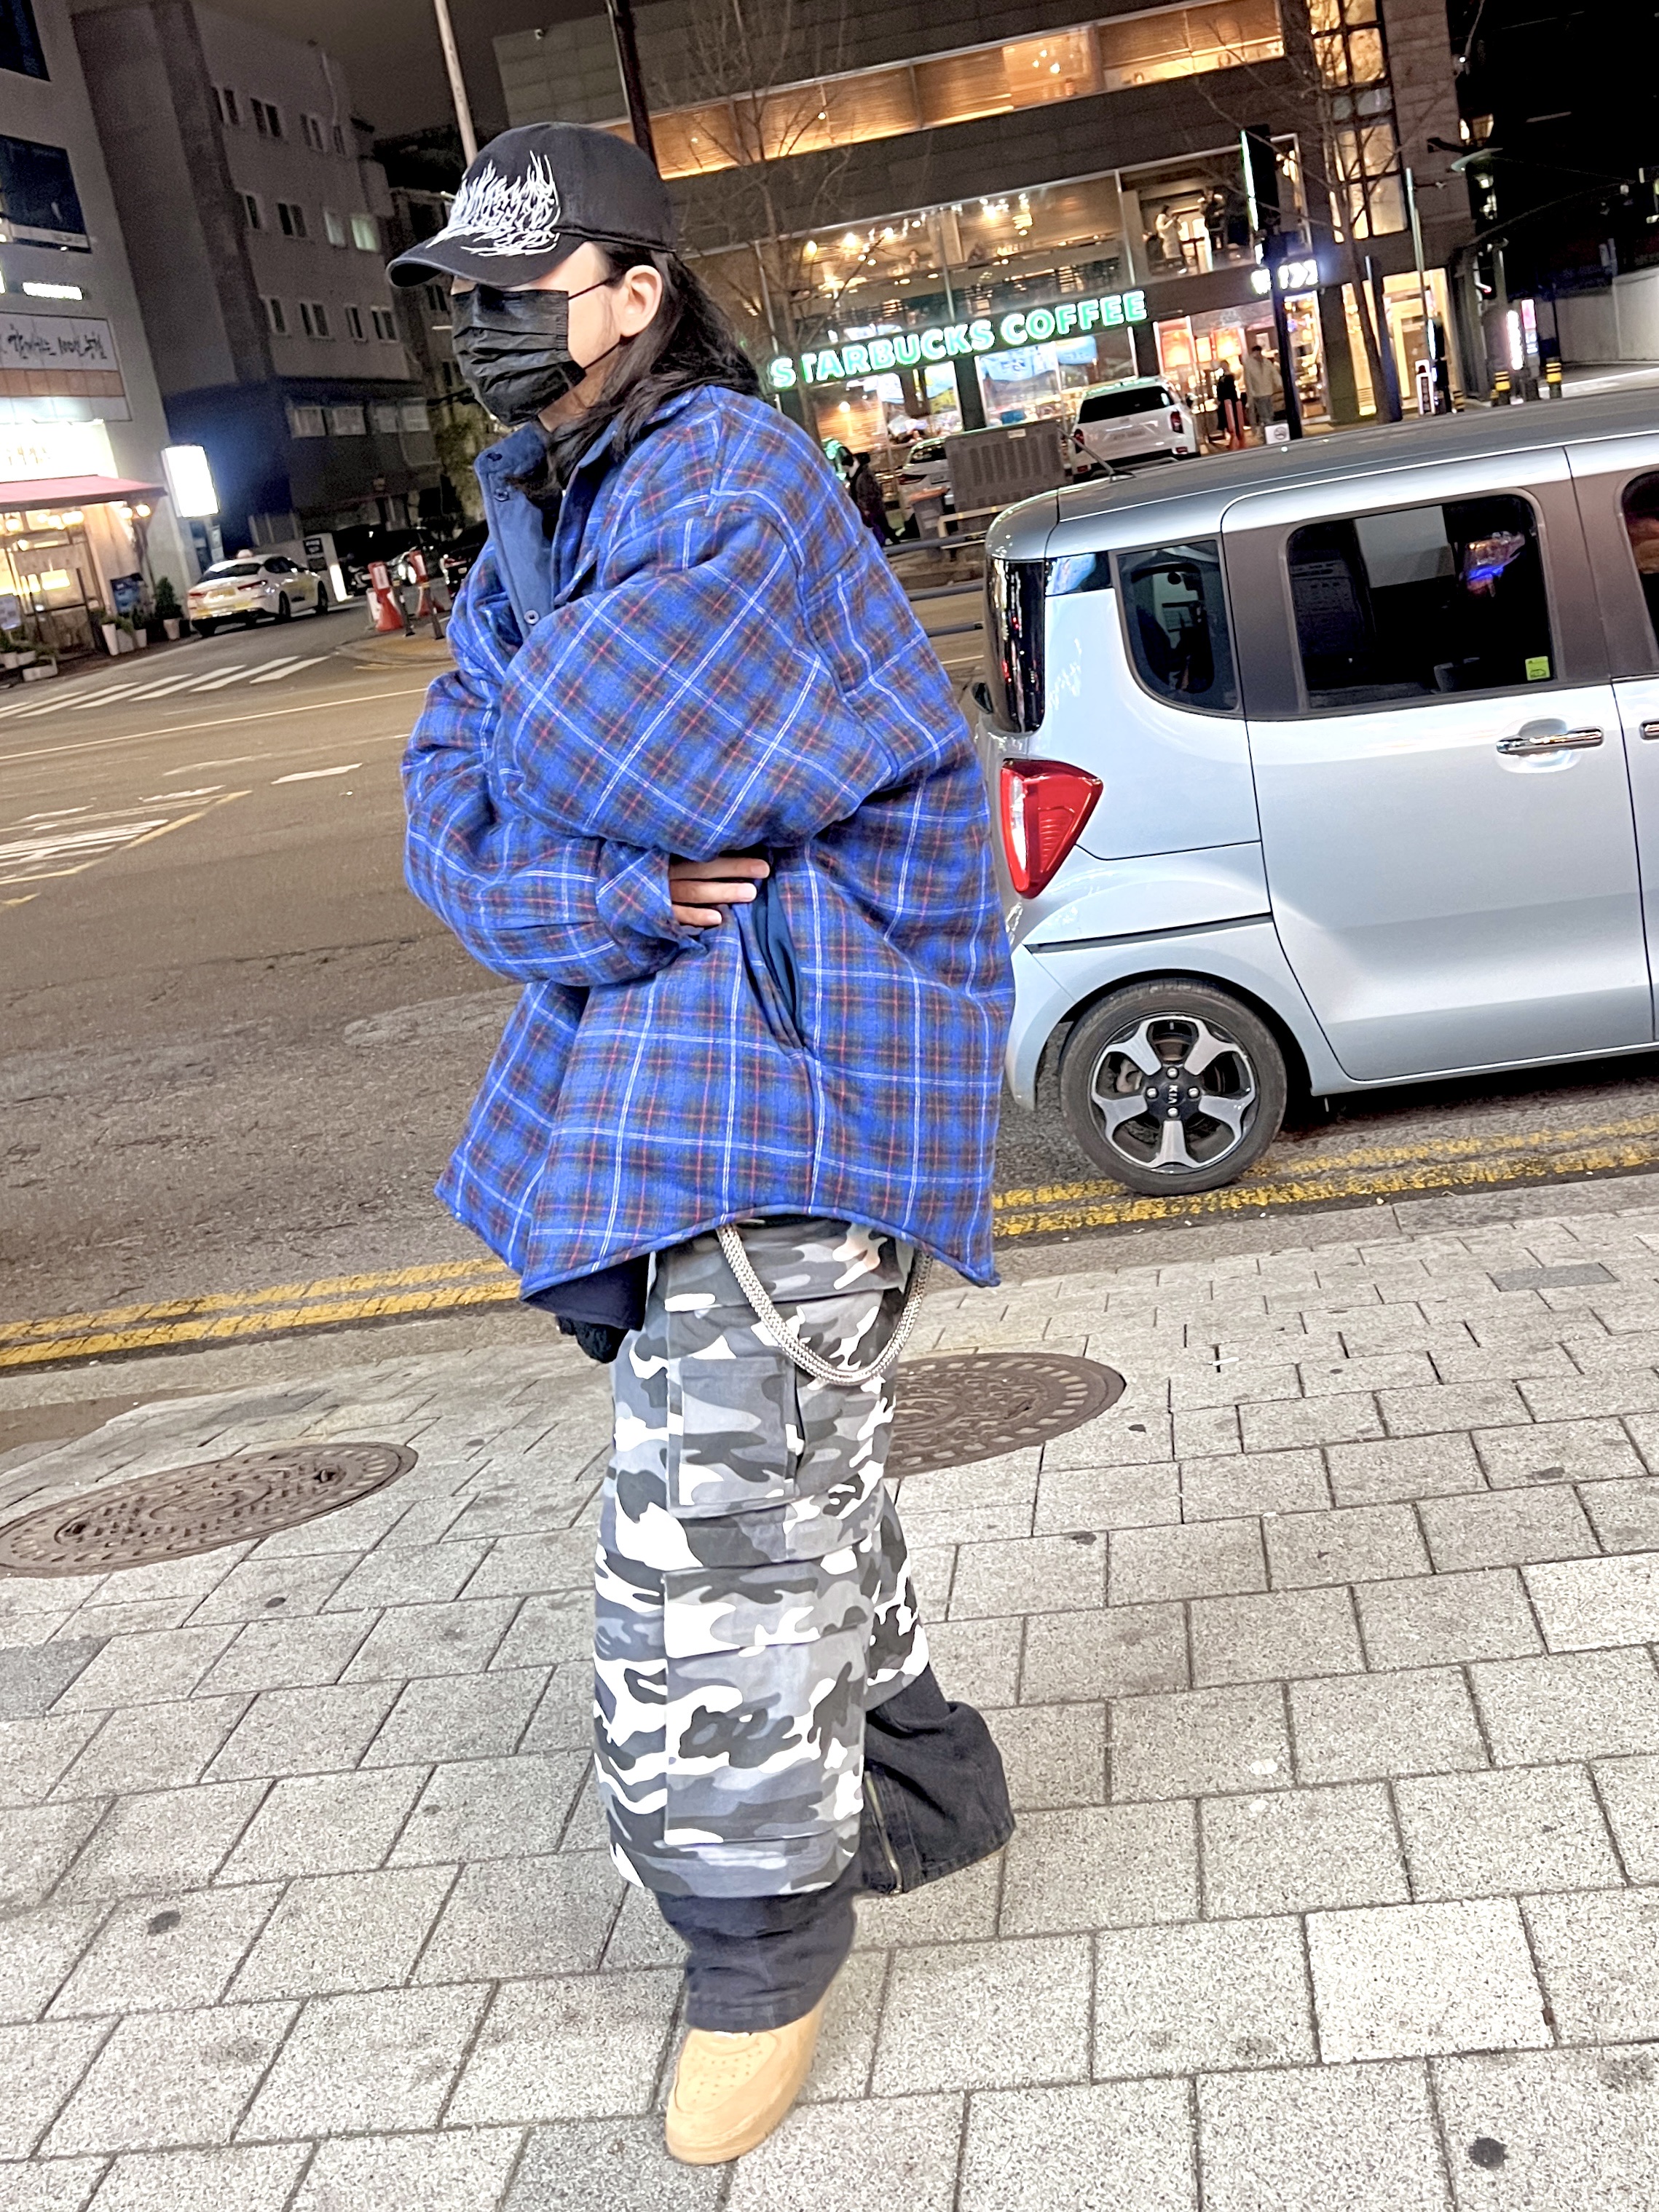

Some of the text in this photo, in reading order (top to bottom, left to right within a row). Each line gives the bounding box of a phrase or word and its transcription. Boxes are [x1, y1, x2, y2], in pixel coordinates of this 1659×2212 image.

[771, 290, 1148, 388] STARBUCKS COFFEE
[1168, 1085, 1178, 1104] KIA
